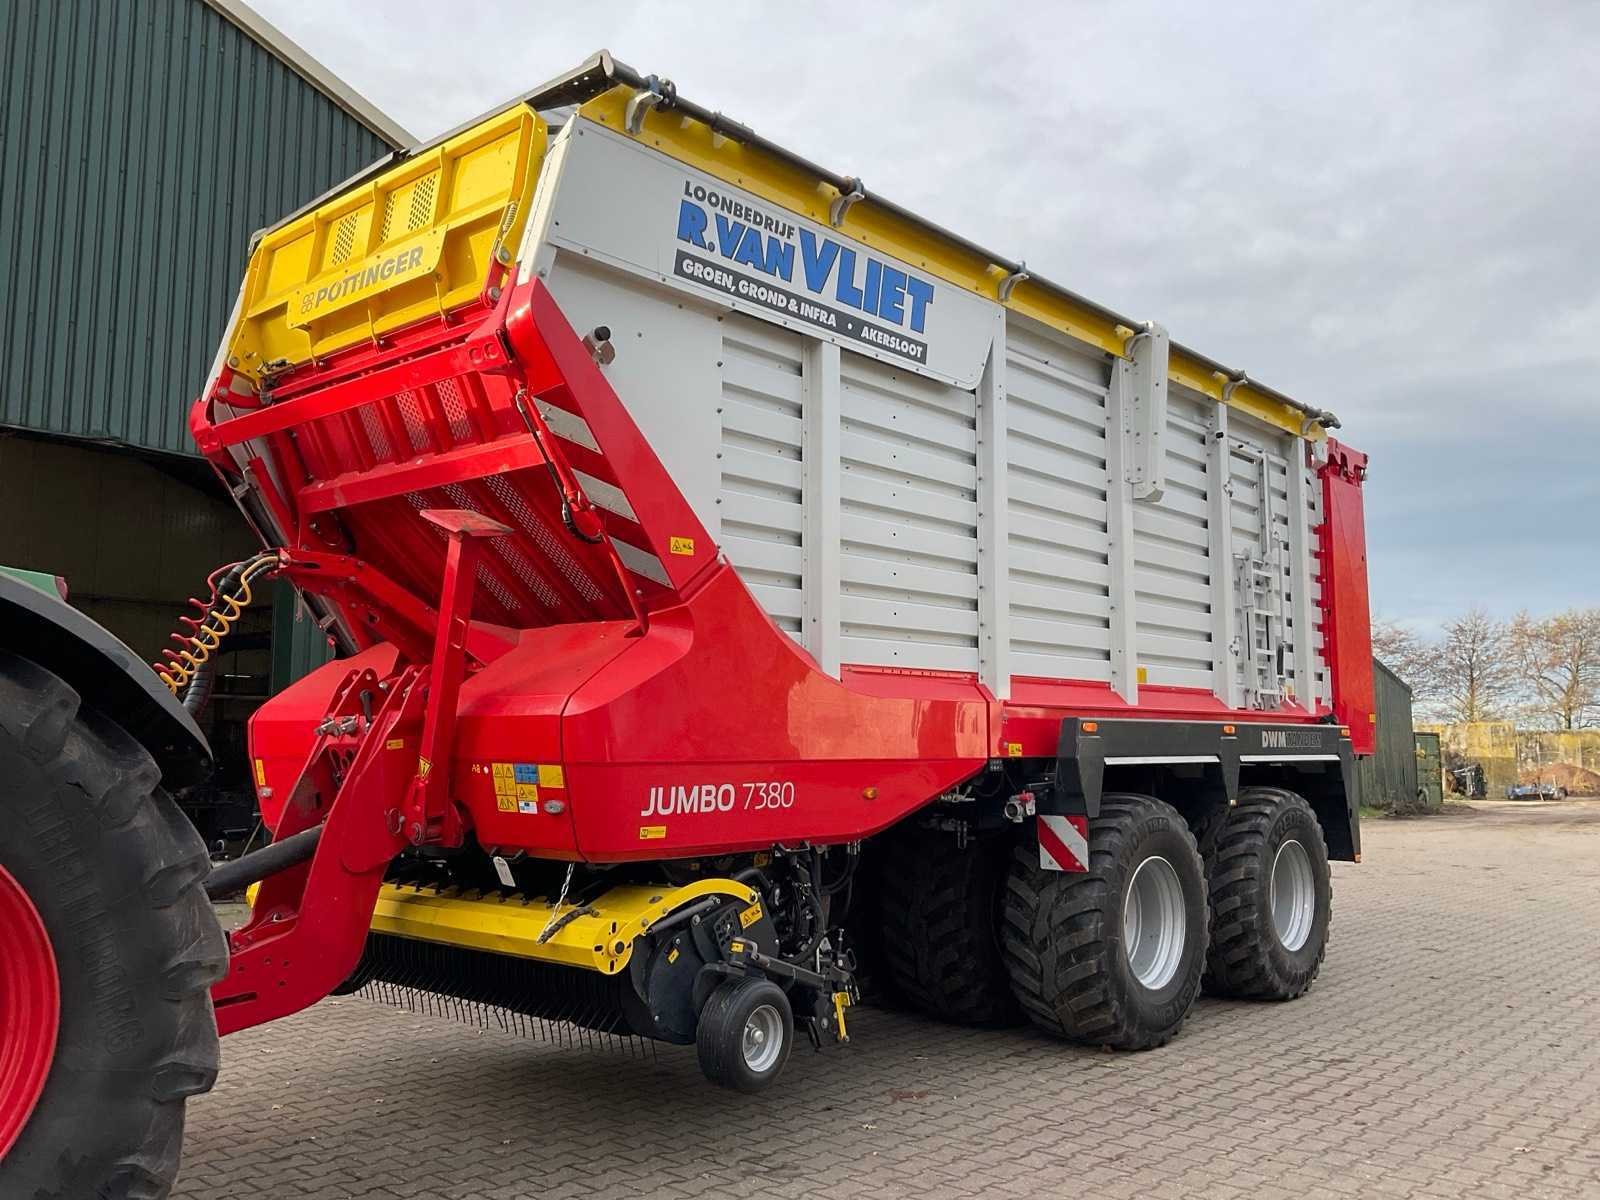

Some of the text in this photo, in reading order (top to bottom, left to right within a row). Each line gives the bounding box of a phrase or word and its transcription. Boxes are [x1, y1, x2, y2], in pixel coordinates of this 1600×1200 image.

[684, 180, 795, 239] LOONBEDRIJF
[682, 258, 924, 359] GROEN, GROND & INFRA AKERSLOOT
[799, 226, 935, 334] VLIET
[1261, 730, 1287, 748] DWM
[640, 781, 795, 817] JUMBO 7380
